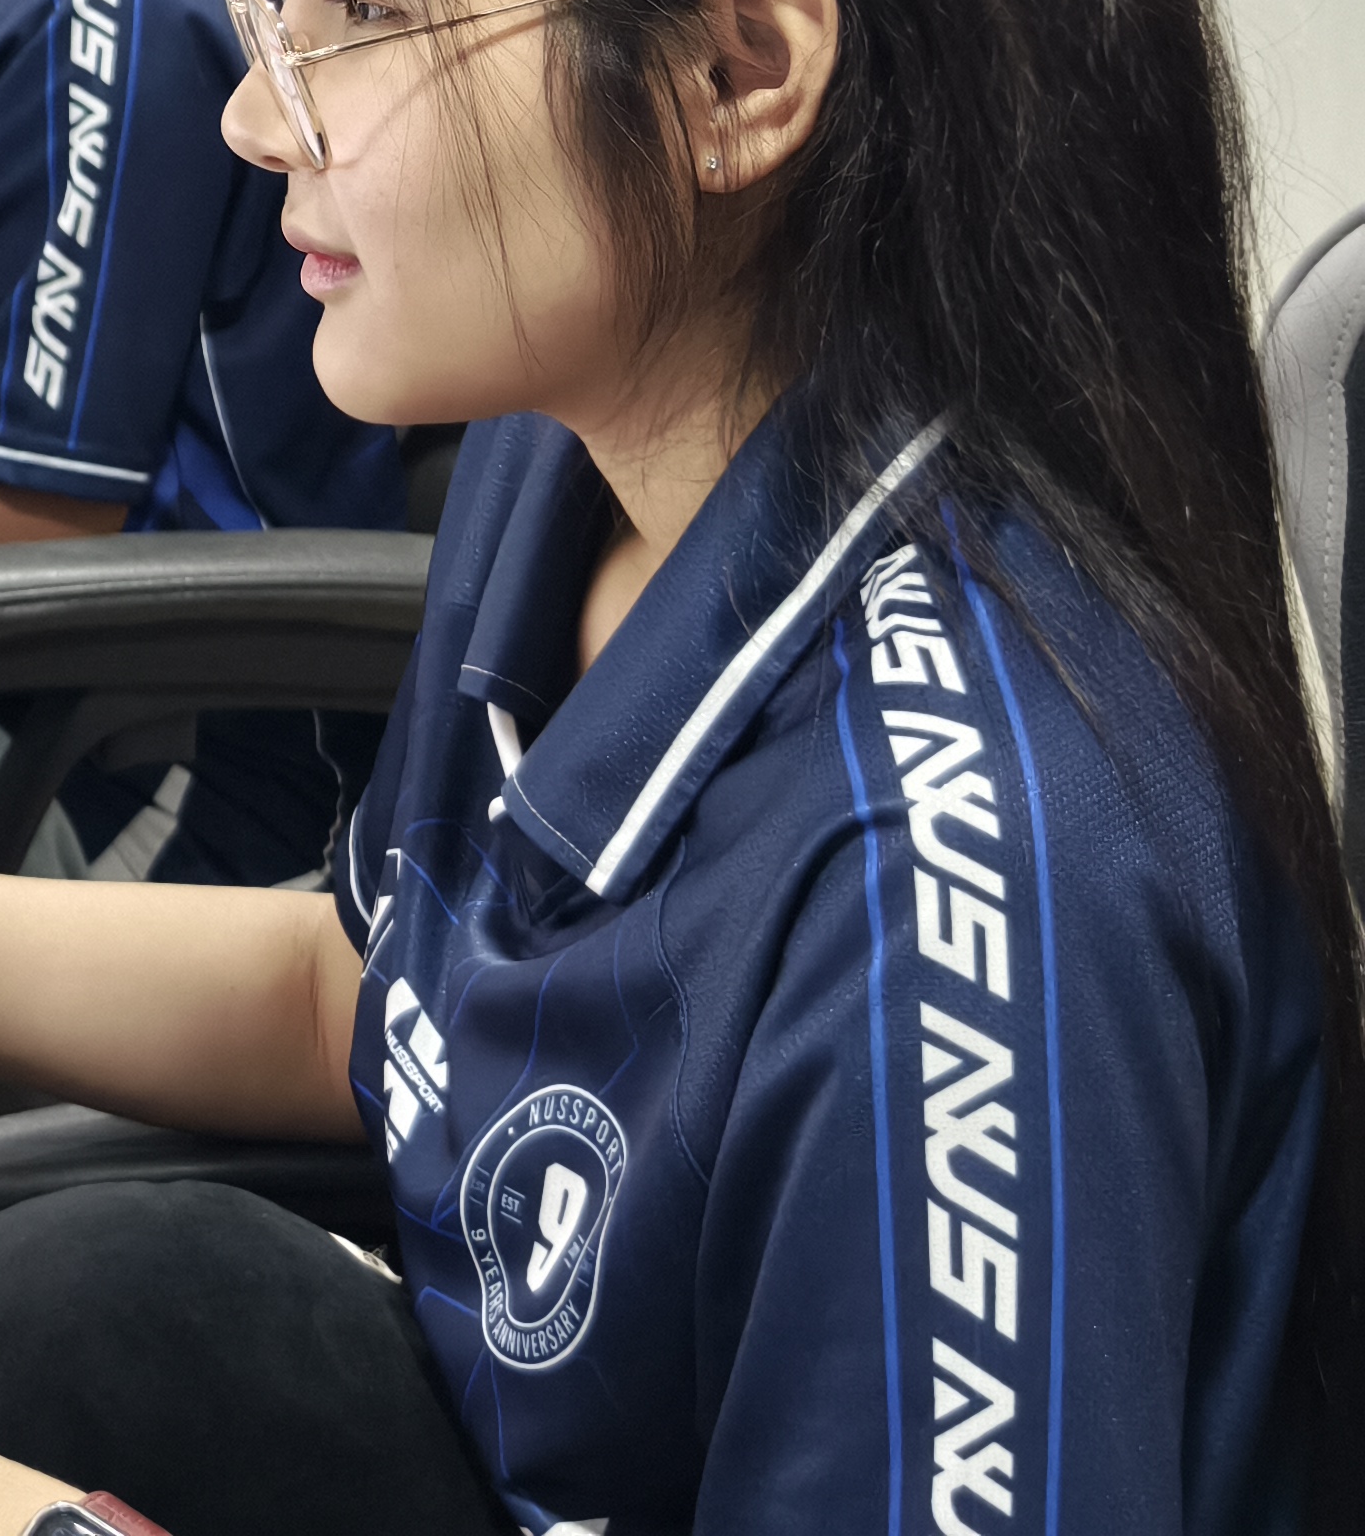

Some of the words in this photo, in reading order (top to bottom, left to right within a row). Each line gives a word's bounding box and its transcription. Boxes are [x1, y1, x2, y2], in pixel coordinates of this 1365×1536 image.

[56, 81, 112, 248] NUS
[24, 239, 84, 410] NUS
[880, 709, 1011, 1002] NUS
[383, 1028, 444, 1115] NUSSPORT
[528, 1094, 624, 1176] NUSSPORT
[920, 1000, 1018, 1342] NUS
[471, 1228, 487, 1243] 9
[500, 1193, 521, 1214] EST
[526, 1162, 588, 1293] 9
[480, 1250, 505, 1324] YEARS
[490, 1298, 582, 1359] ANNIVERSARY
